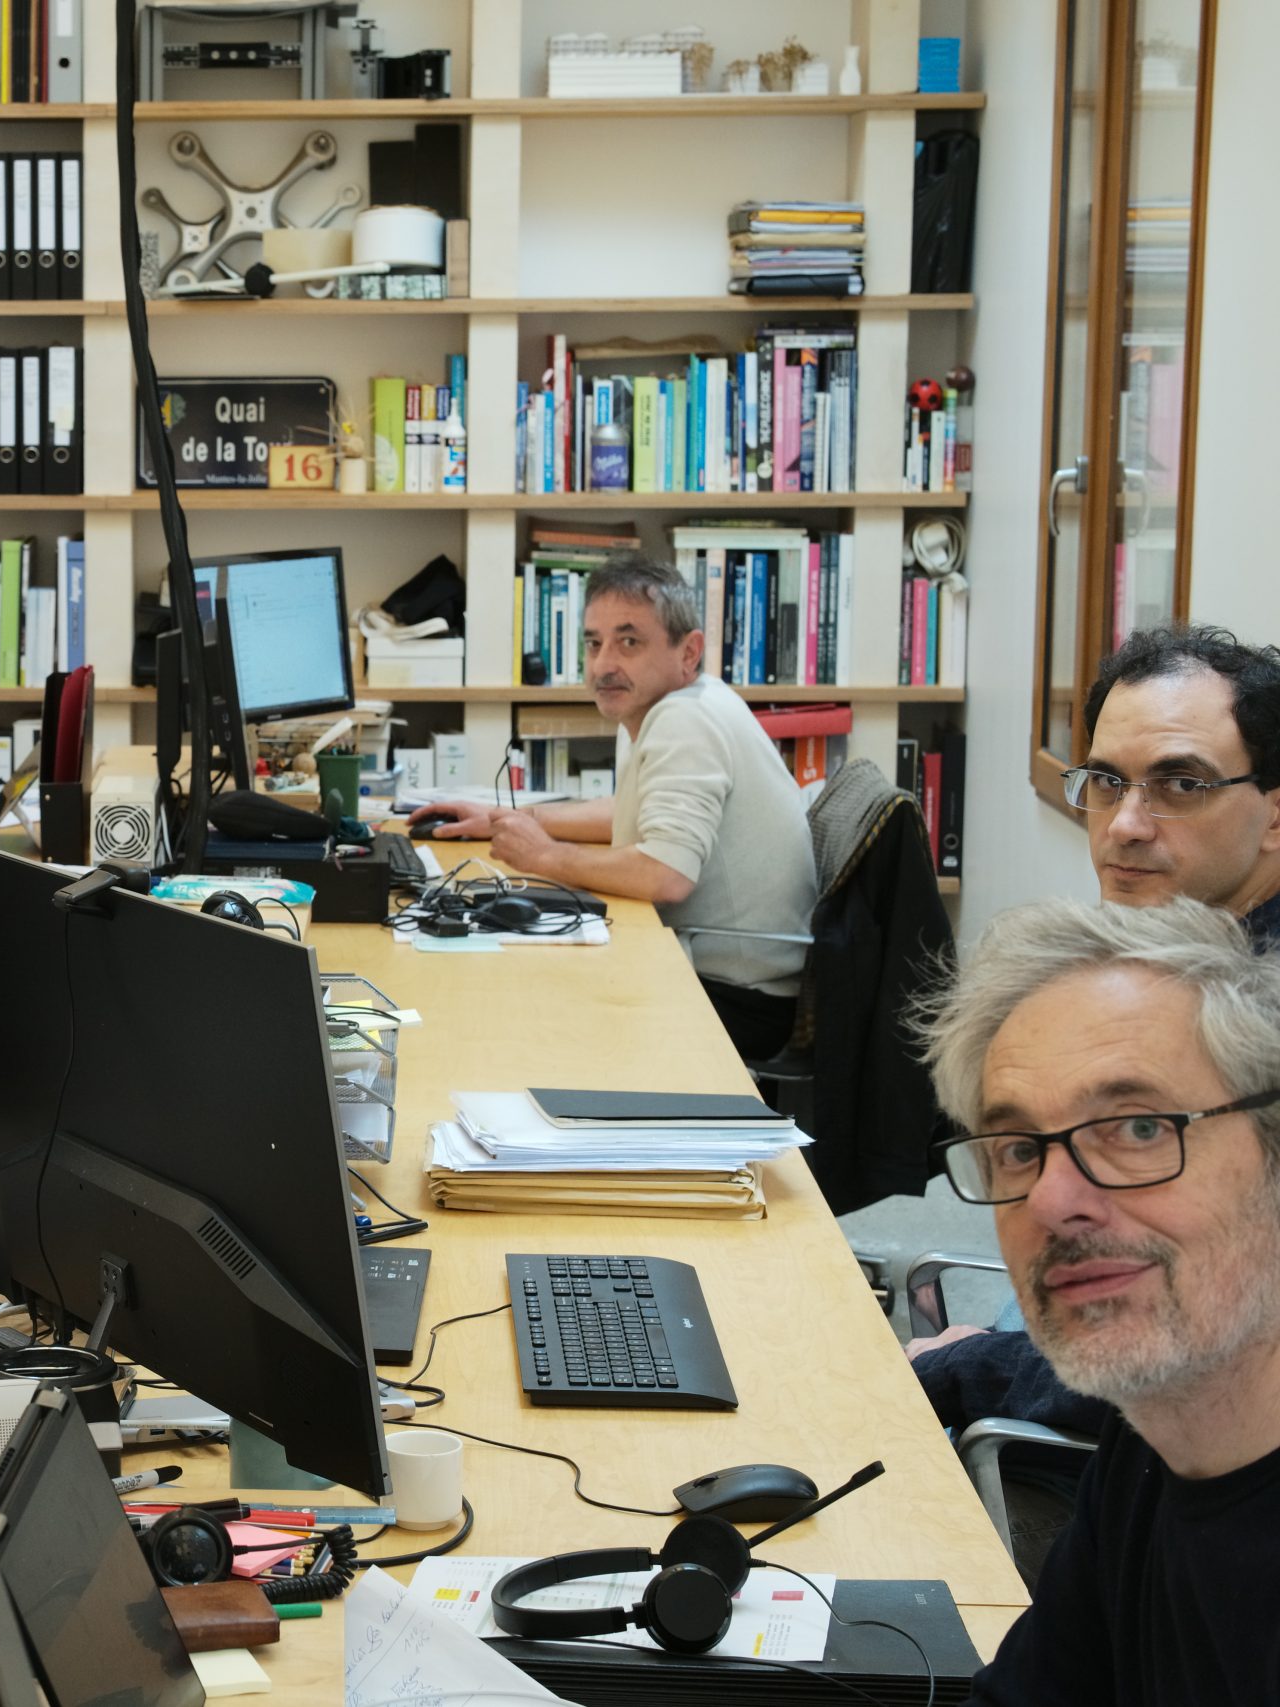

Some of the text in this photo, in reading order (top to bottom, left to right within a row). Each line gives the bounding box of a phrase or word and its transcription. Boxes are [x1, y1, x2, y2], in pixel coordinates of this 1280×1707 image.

[215, 396, 266, 424] Quai
[181, 436, 209, 462] de
[216, 436, 236, 462] la
[284, 453, 323, 481] 16
